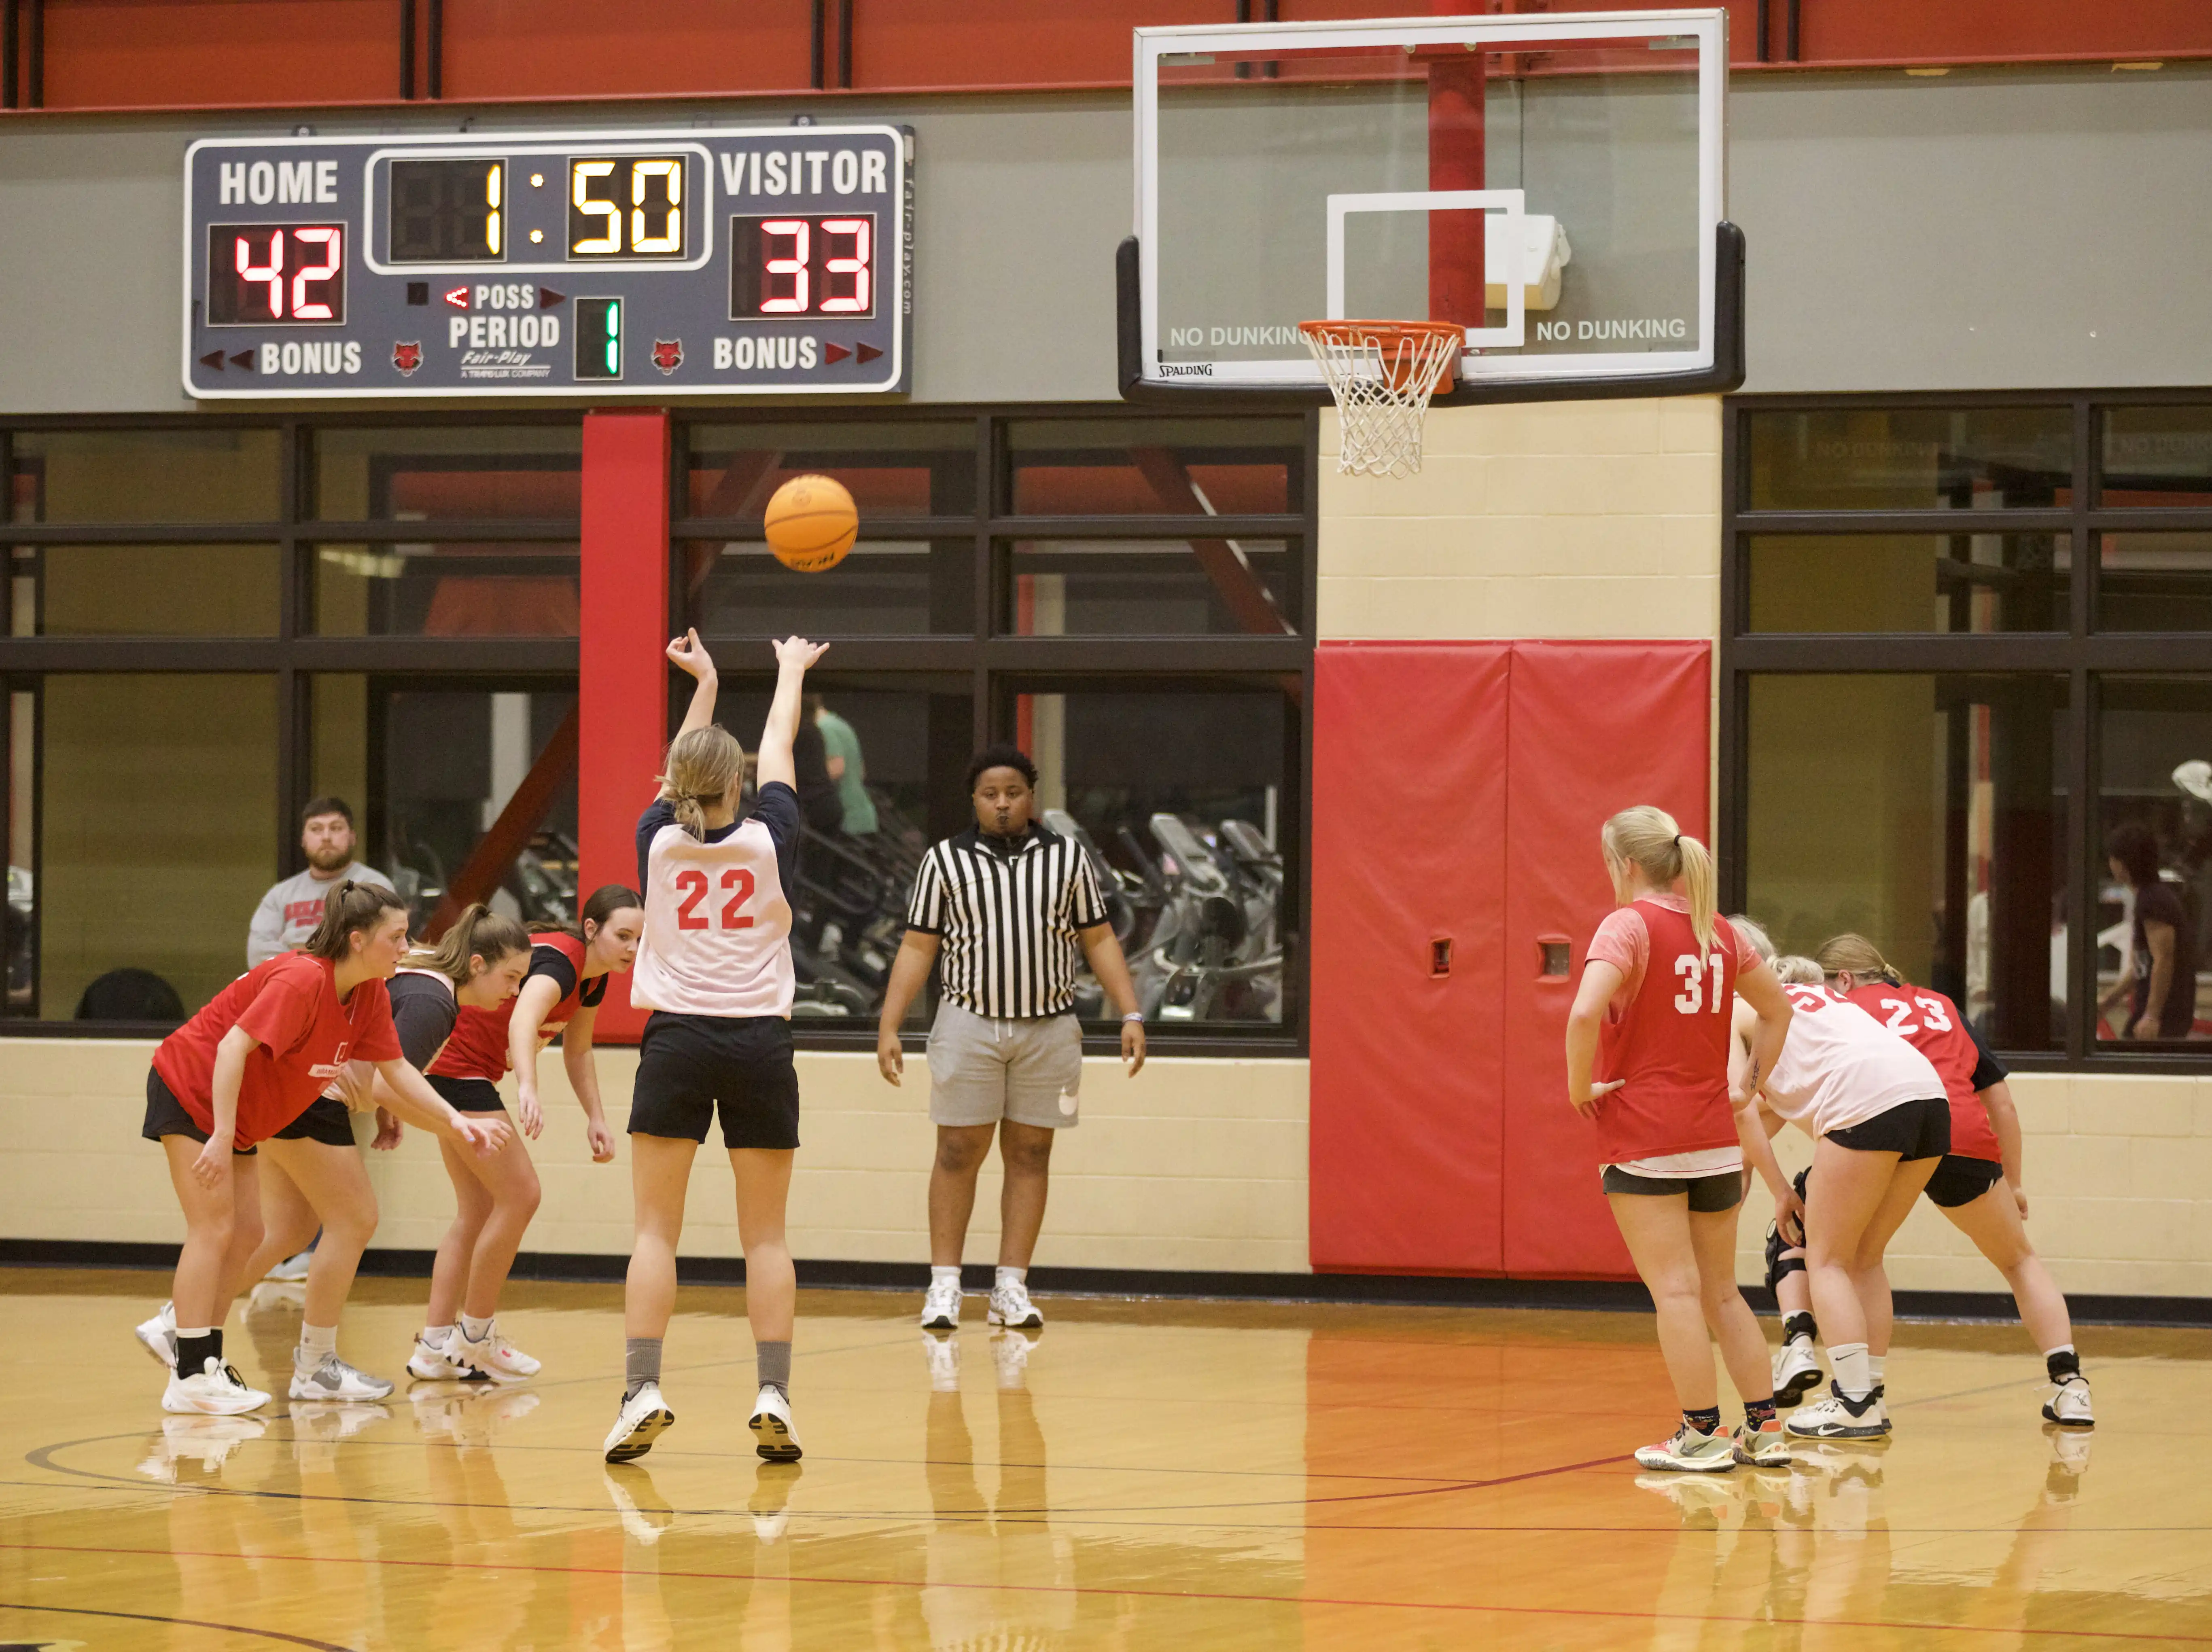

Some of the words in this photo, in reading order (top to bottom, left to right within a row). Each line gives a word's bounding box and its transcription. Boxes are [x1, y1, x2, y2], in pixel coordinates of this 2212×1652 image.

[221, 161, 338, 205] HOME
[720, 150, 887, 196] VISITOR
[235, 228, 341, 319] 42
[760, 220, 870, 313] 33
[475, 284, 534, 310] POSS
[450, 315, 560, 349] PERIOD
[606, 302, 619, 375] 1
[1171, 327, 1204, 347] NO
[1537, 322, 1571, 341] NO
[1578, 319, 1686, 340] DUNKING
[262, 342, 362, 375] BONUS
[461, 350, 532, 366] Fair-Play
[714, 336, 817, 370] BONUS
[461, 370, 468, 378] A
[511, 369, 551, 378] COMPANY
[1159, 364, 1213, 378] SPALDING
[676, 869, 755, 930] 22
[1674, 953, 1724, 1014] 31
[1880, 995, 1952, 1036] 23
